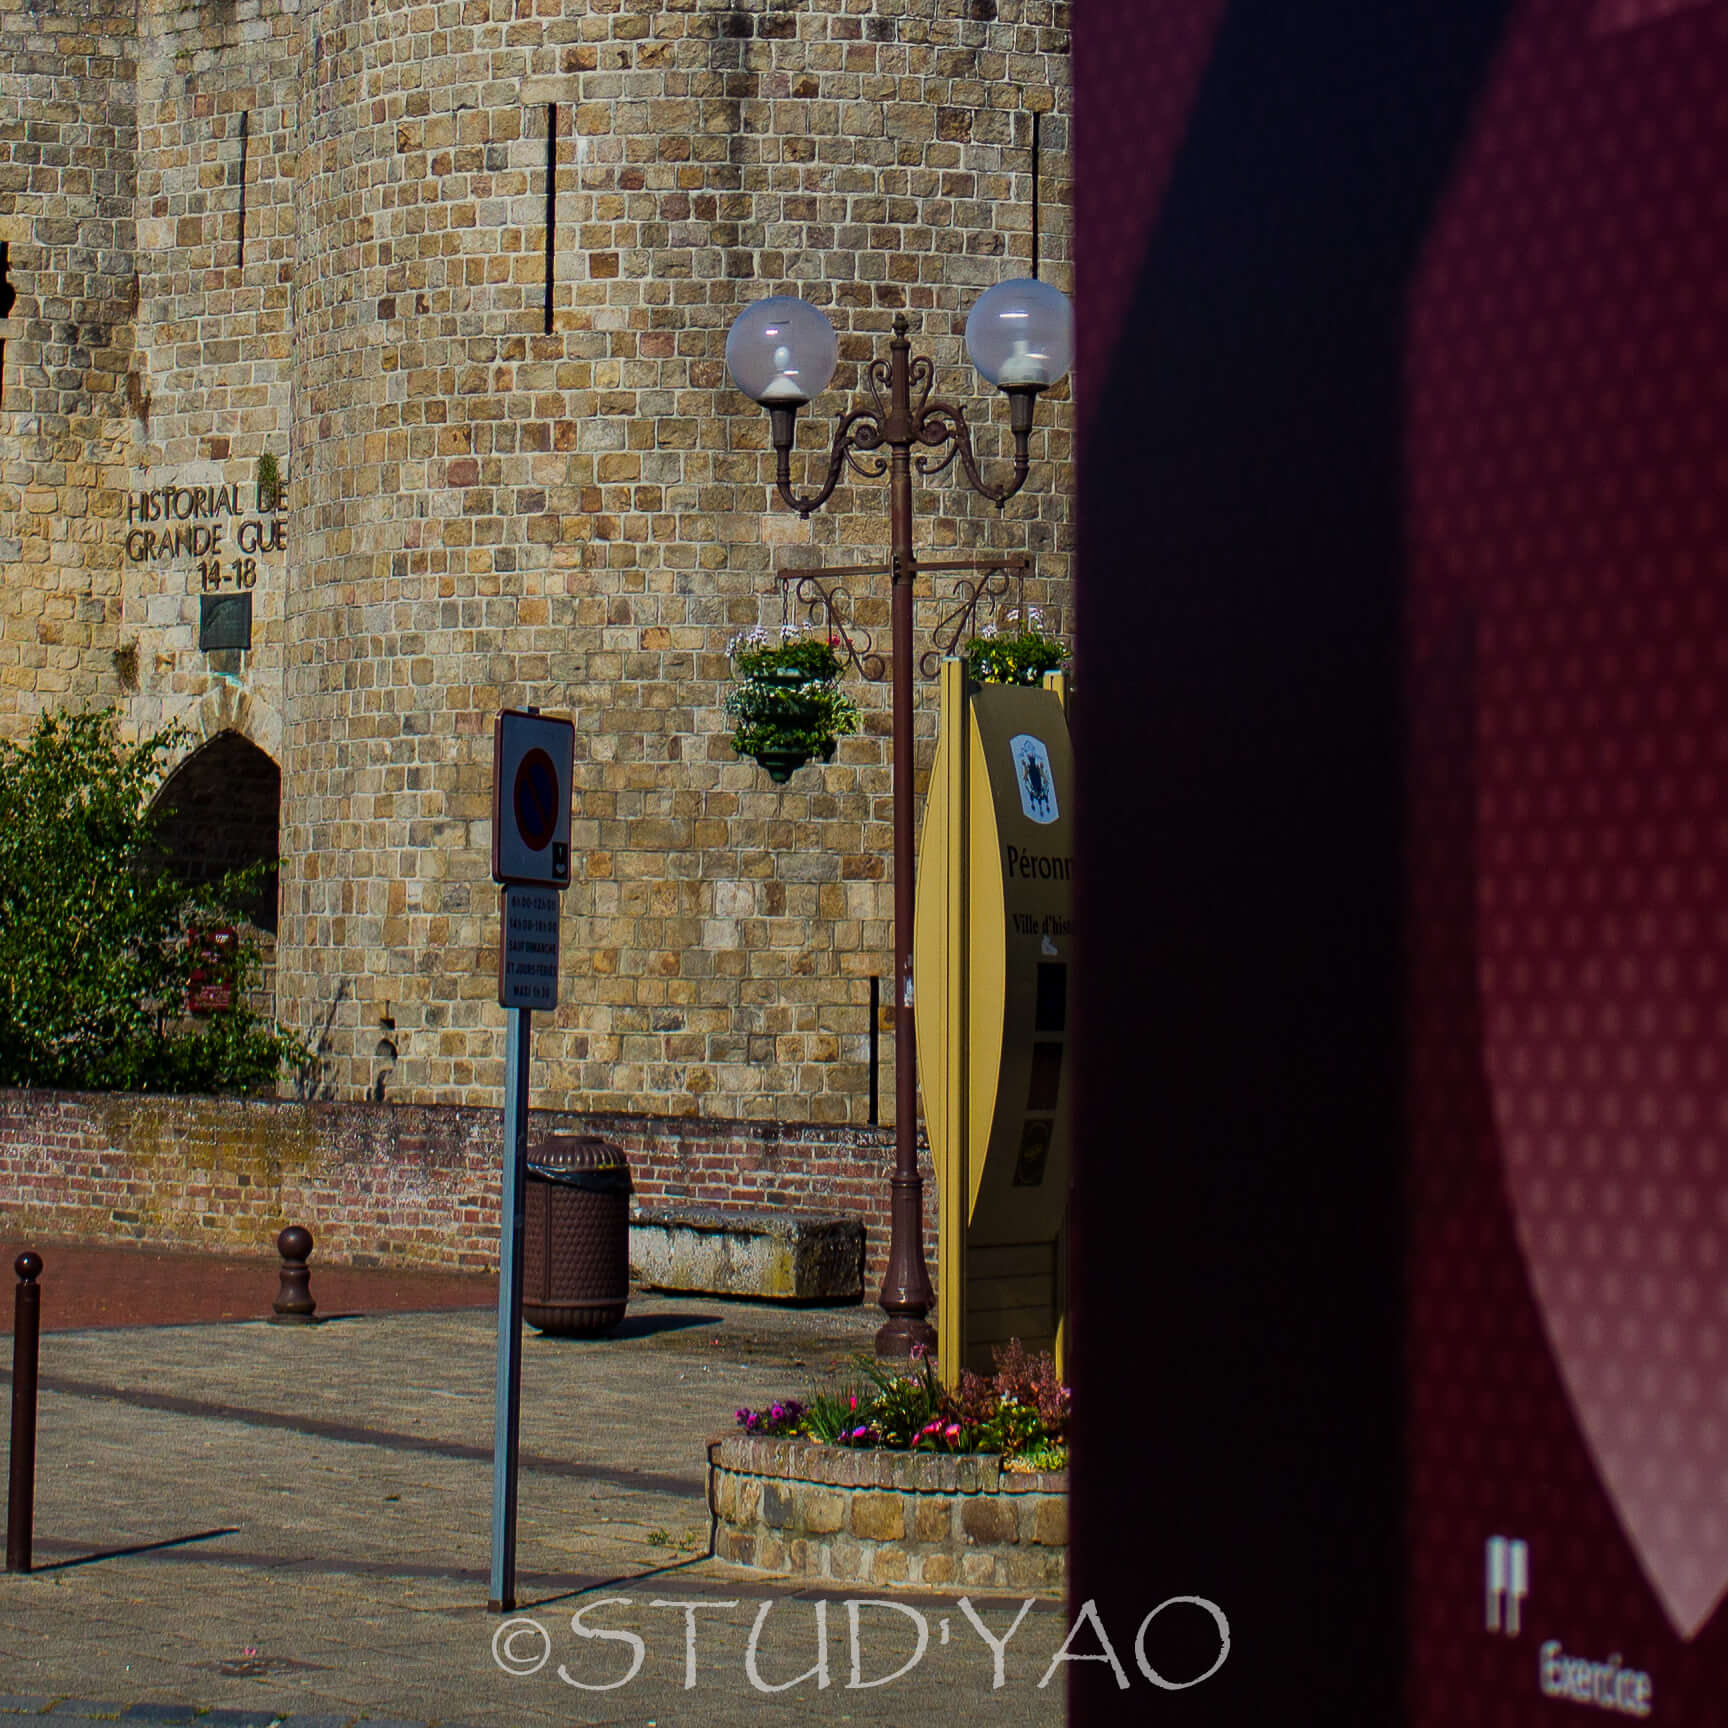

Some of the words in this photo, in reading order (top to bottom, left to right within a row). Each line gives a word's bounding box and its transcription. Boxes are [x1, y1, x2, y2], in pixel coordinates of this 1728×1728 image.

[128, 483, 243, 523] HISTORIAL
[125, 525, 222, 562] GRANDE
[198, 557, 257, 592] 14-18
[1012, 913, 1039, 935] Ville
